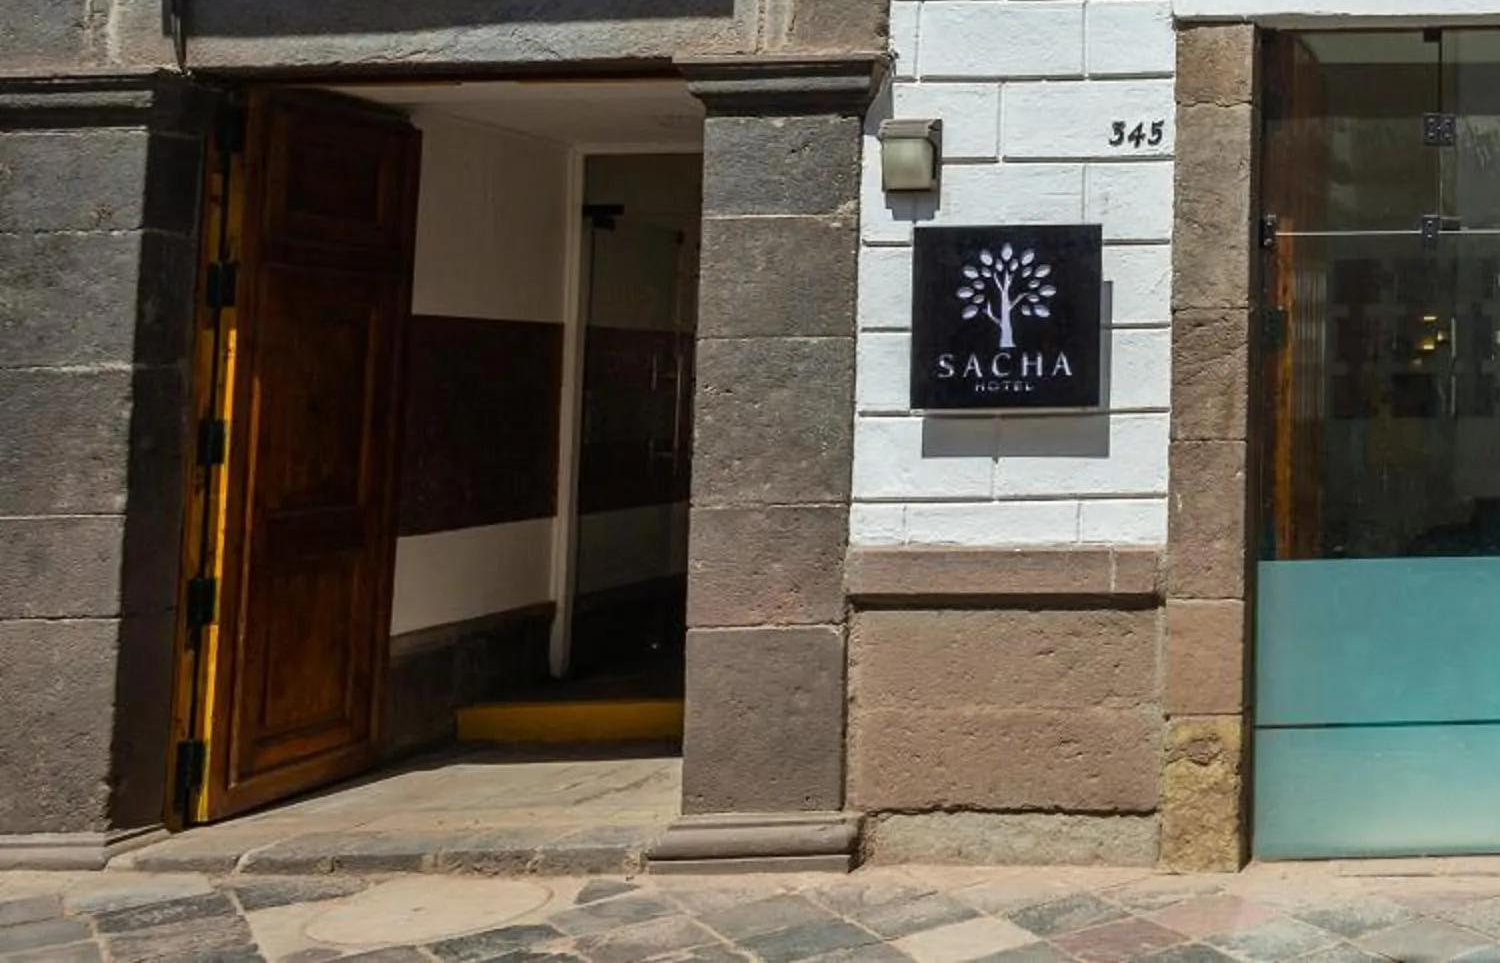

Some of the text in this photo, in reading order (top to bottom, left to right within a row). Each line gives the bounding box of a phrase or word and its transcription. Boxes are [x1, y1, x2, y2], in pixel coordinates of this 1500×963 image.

[1108, 120, 1165, 148] 345
[938, 351, 1072, 378] SACHA
[975, 380, 1034, 392] HOTEL
